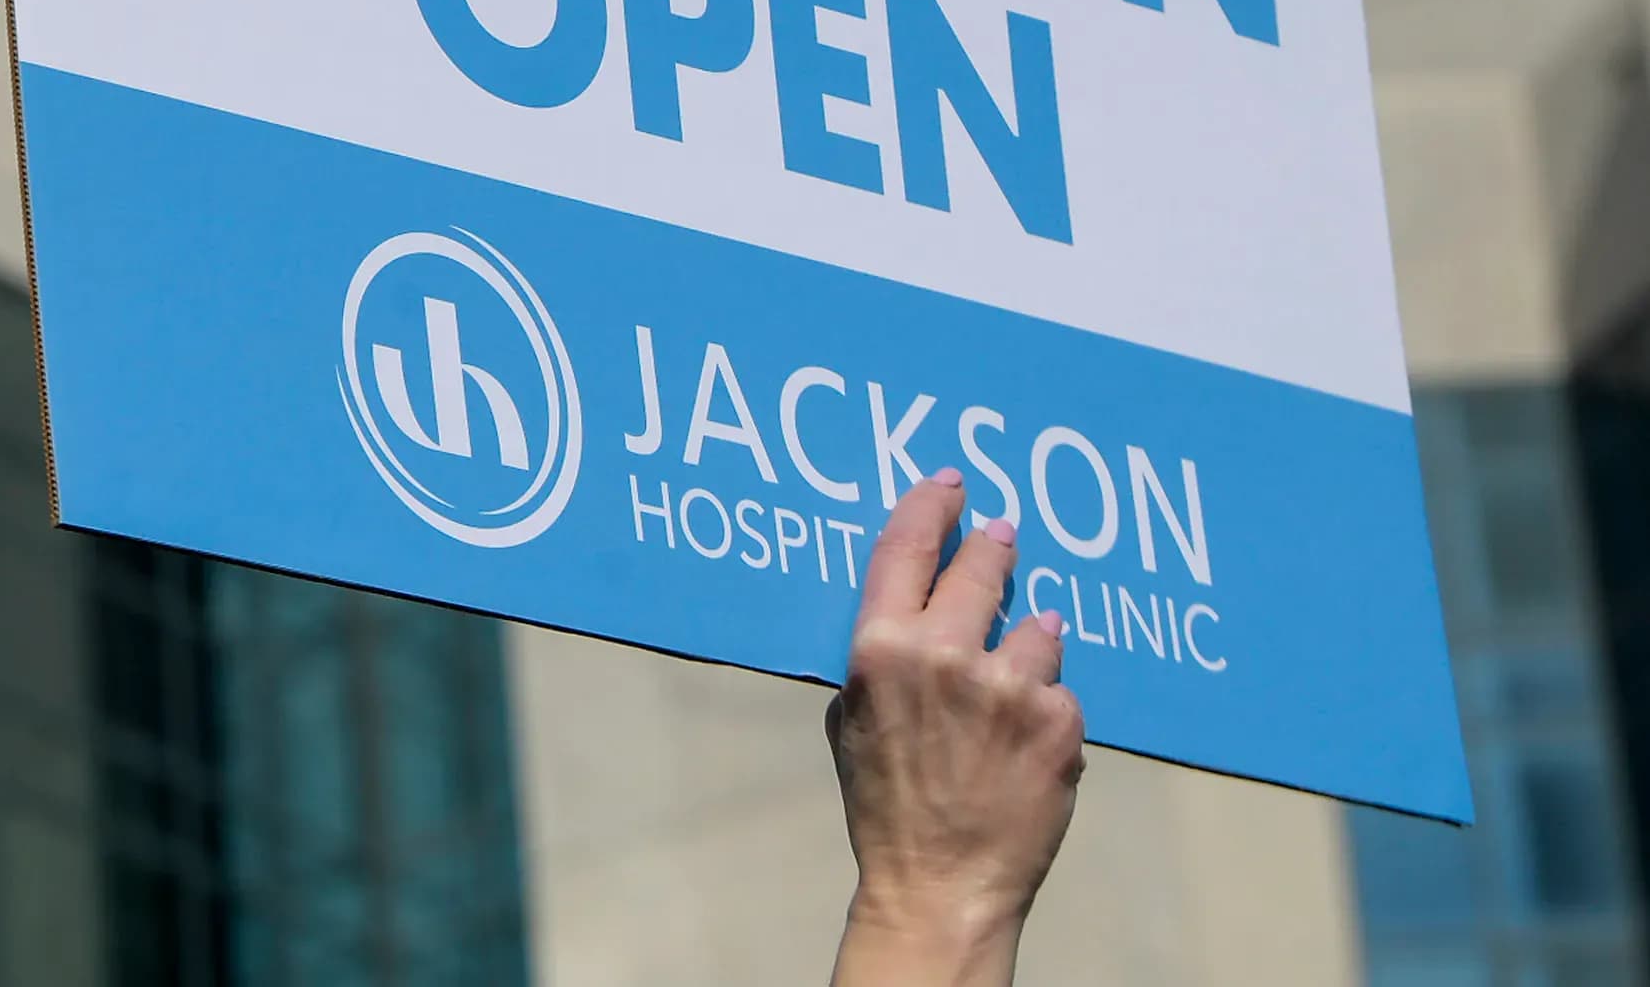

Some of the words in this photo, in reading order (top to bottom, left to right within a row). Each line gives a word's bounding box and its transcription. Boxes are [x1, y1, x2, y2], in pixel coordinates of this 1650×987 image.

[623, 324, 1214, 587] JACKSON
[629, 473, 886, 589] HOSPIT
[1026, 566, 1227, 673] CLINIC
